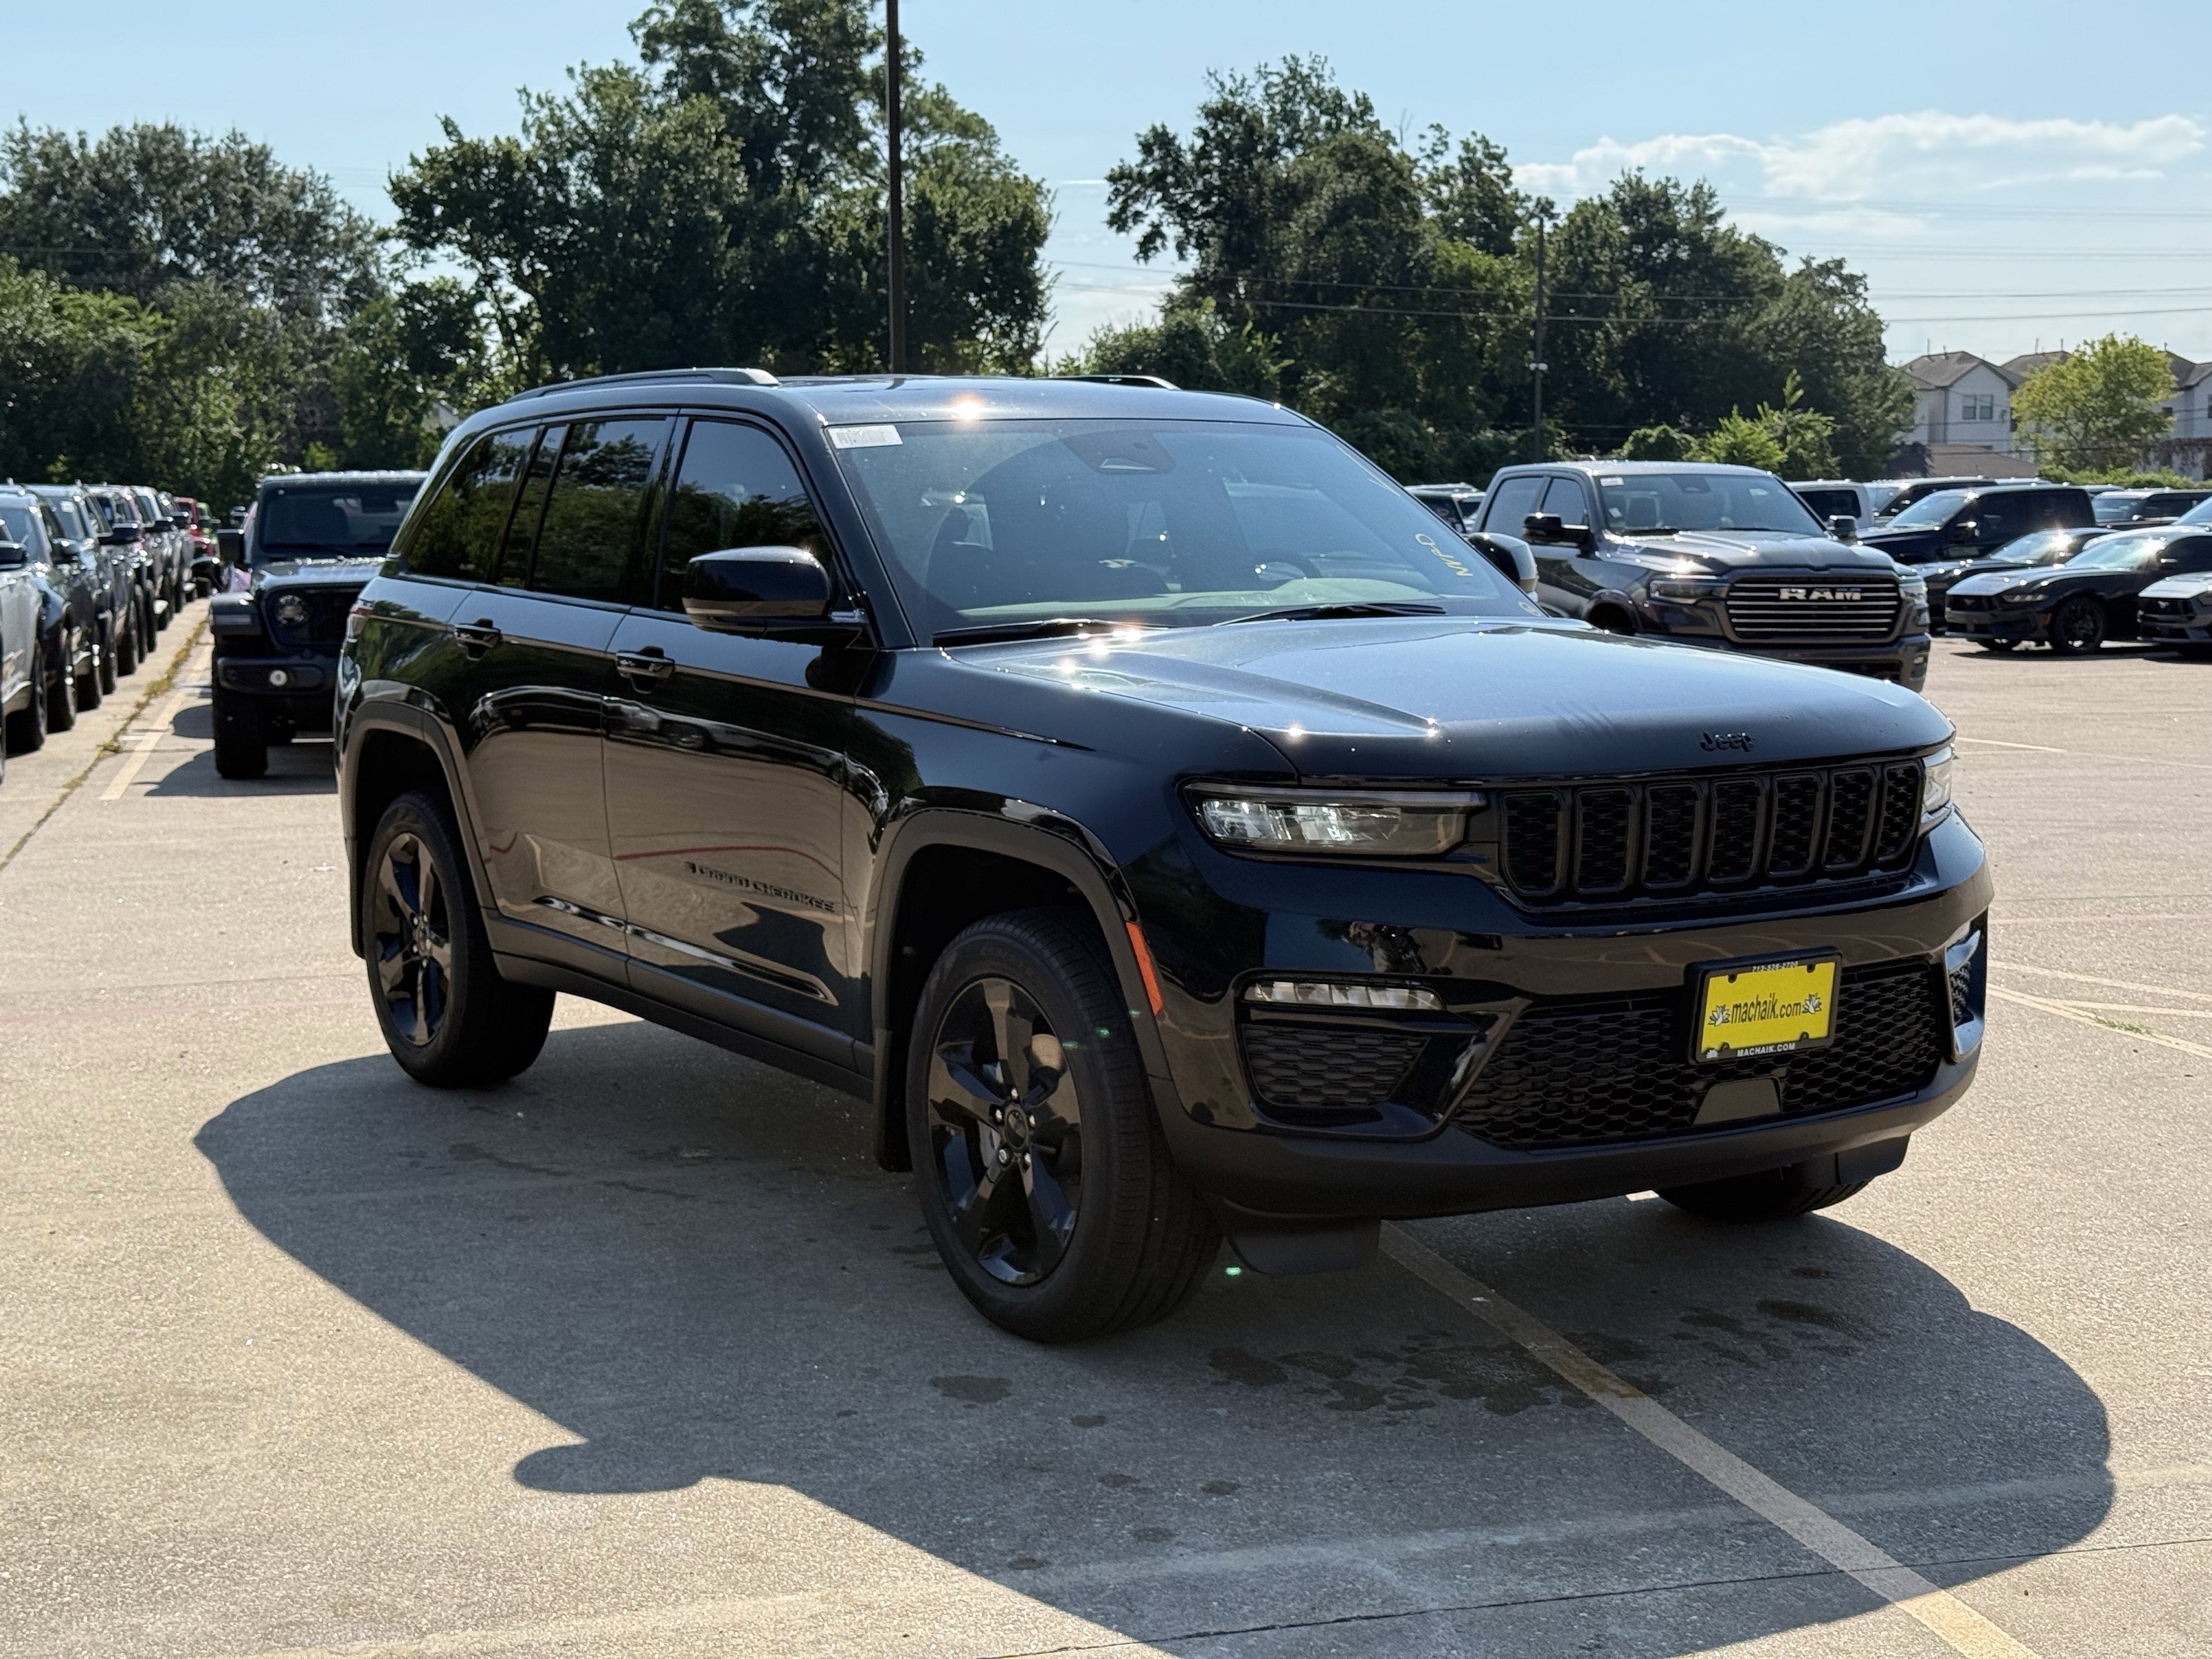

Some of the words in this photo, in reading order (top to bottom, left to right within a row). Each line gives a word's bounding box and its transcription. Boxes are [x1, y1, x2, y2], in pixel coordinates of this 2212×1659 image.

[1779, 588, 1861, 600] RAM
[1700, 731, 1755, 752] Jeep
[1731, 992, 1801, 1024] machaik.com
[1737, 1042, 1796, 1057] MACHAIK.COM
